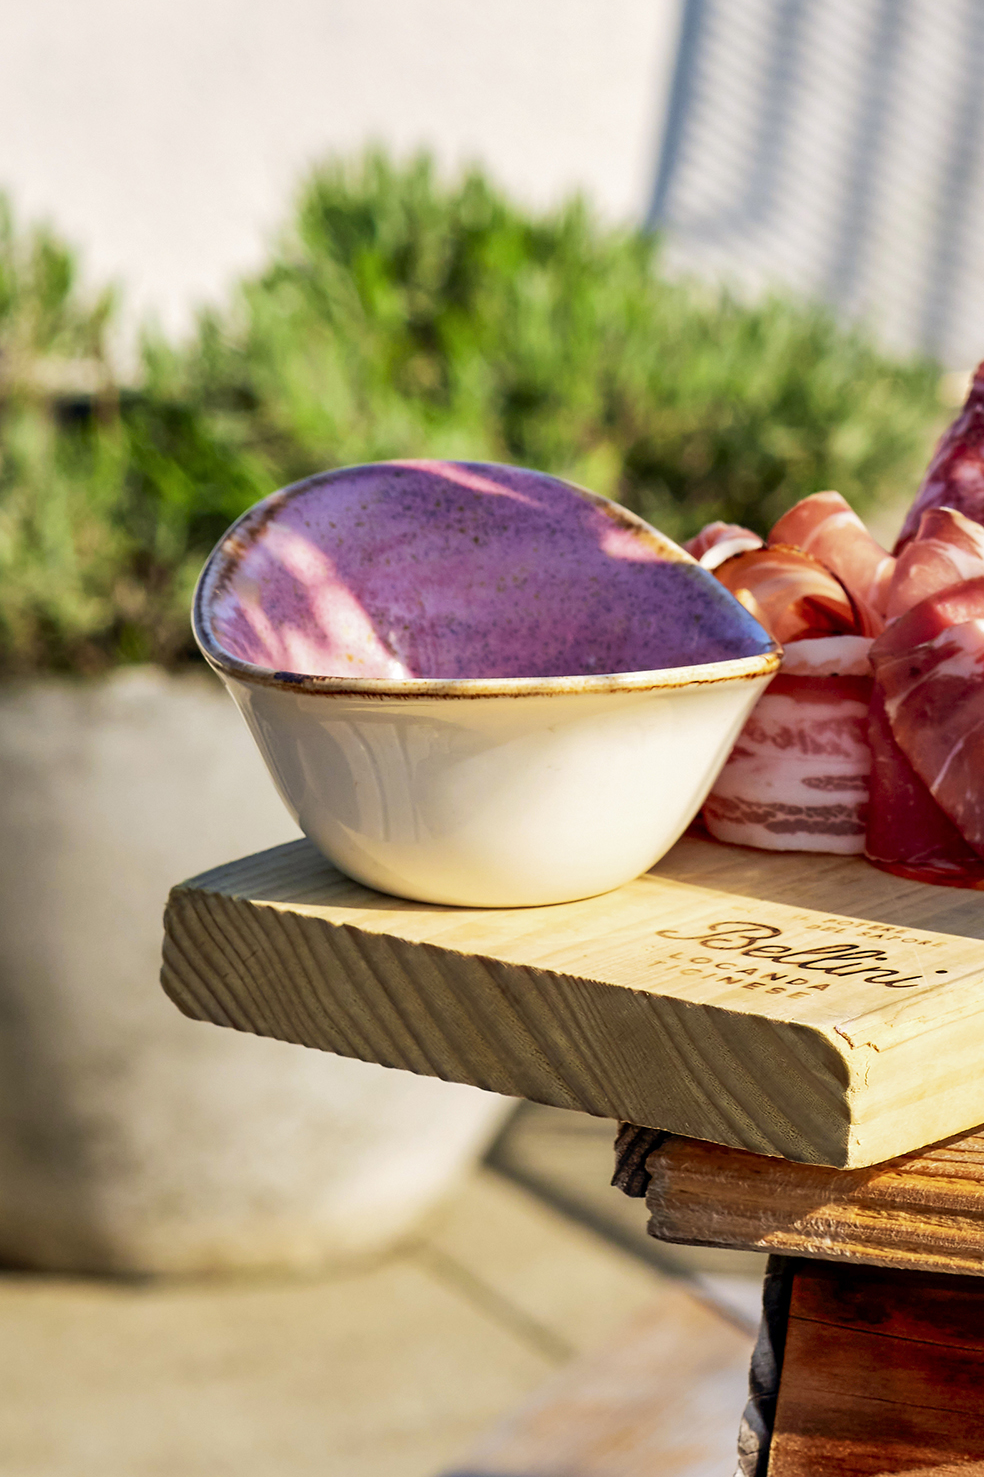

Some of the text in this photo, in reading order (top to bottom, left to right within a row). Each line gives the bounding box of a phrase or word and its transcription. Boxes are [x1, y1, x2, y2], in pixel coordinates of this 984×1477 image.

[804, 924, 948, 948] DEL SAPORE
[822, 918, 911, 934] POTERE
[655, 921, 948, 988] Bellini
[669, 951, 831, 992] LOCANDA
[648, 960, 811, 1000] TICINESE
